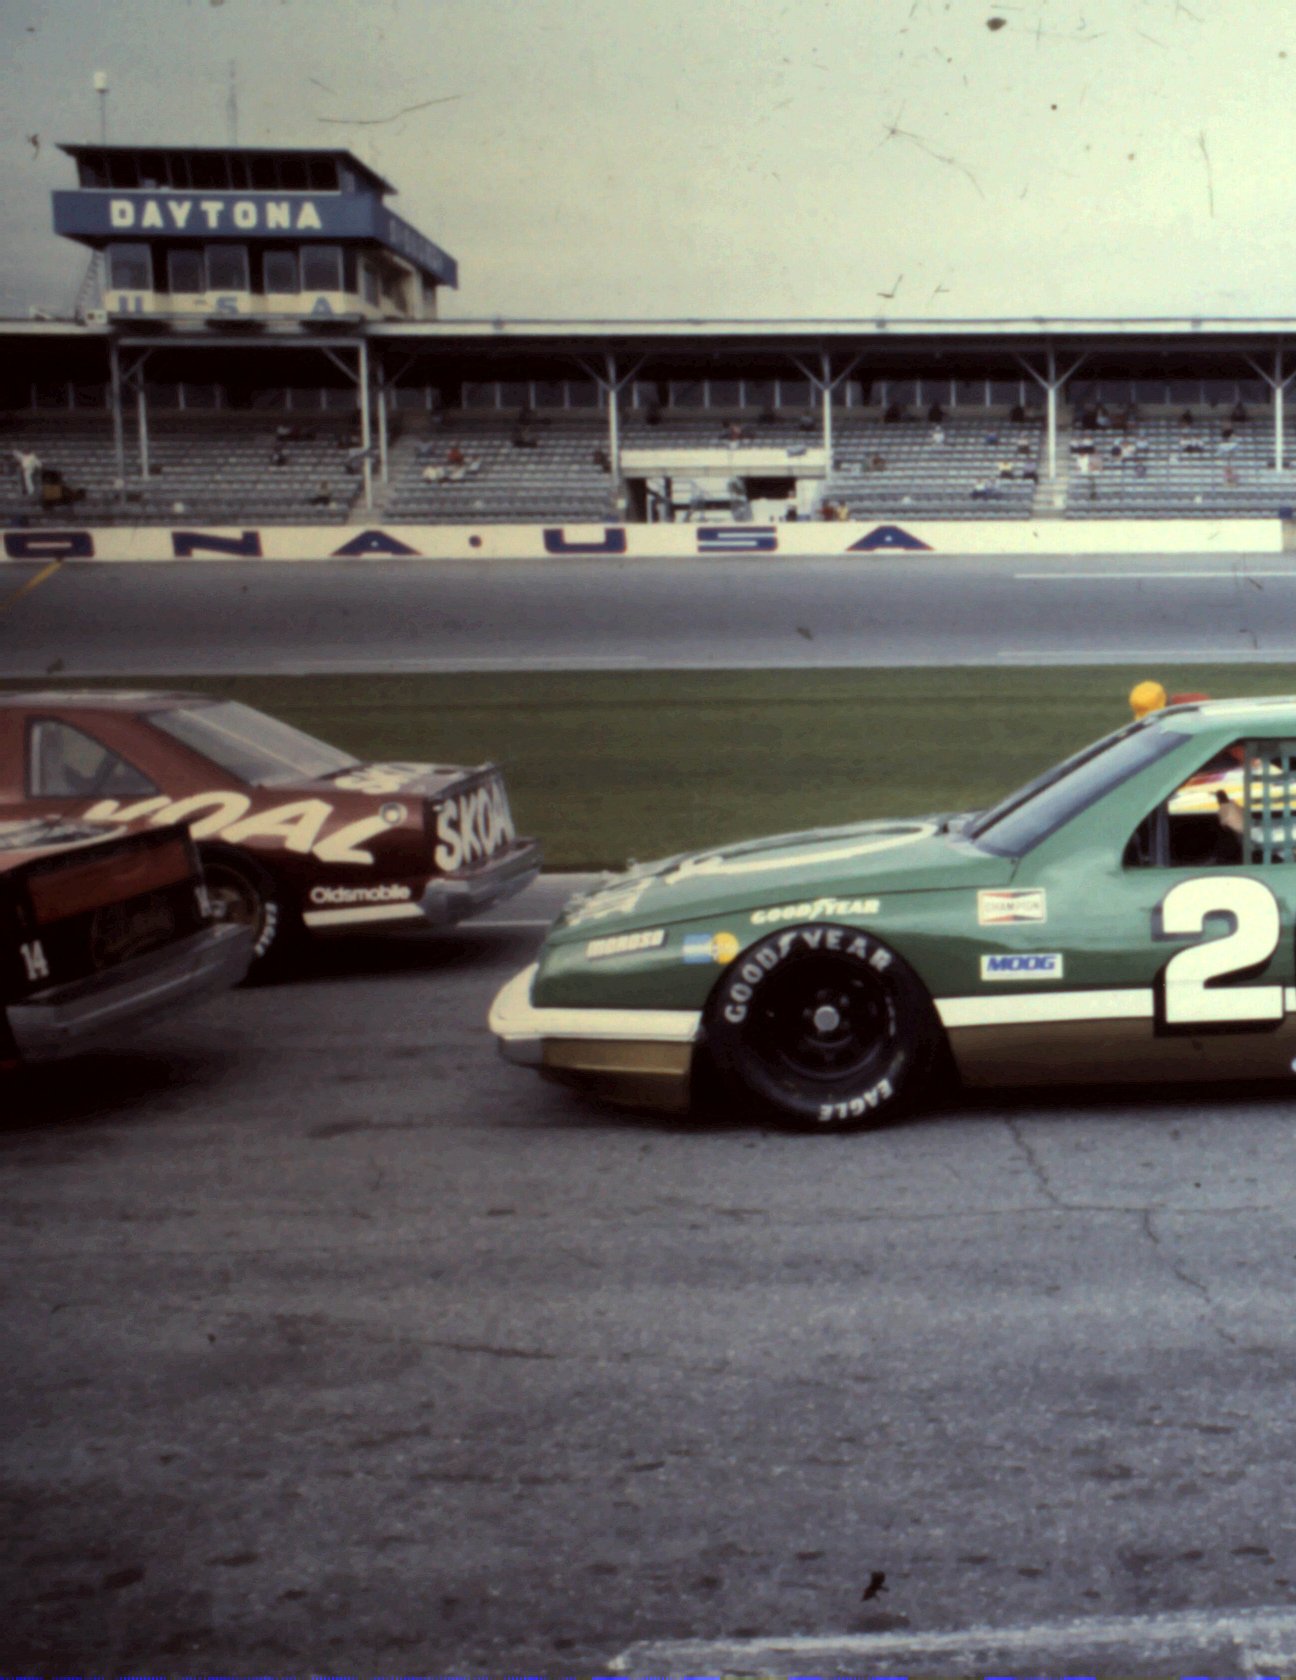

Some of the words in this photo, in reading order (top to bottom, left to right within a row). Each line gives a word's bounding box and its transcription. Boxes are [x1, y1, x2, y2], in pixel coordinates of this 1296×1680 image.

[110, 200, 323, 230] DAYTONA
[310, 884, 411, 904] Oldsmobile
[750, 897, 881, 925] GOODYEAR
[20, 940, 49, 980] 14
[986, 954, 1057, 972] MOOG
[818, 1078, 894, 1122] EAGLE
